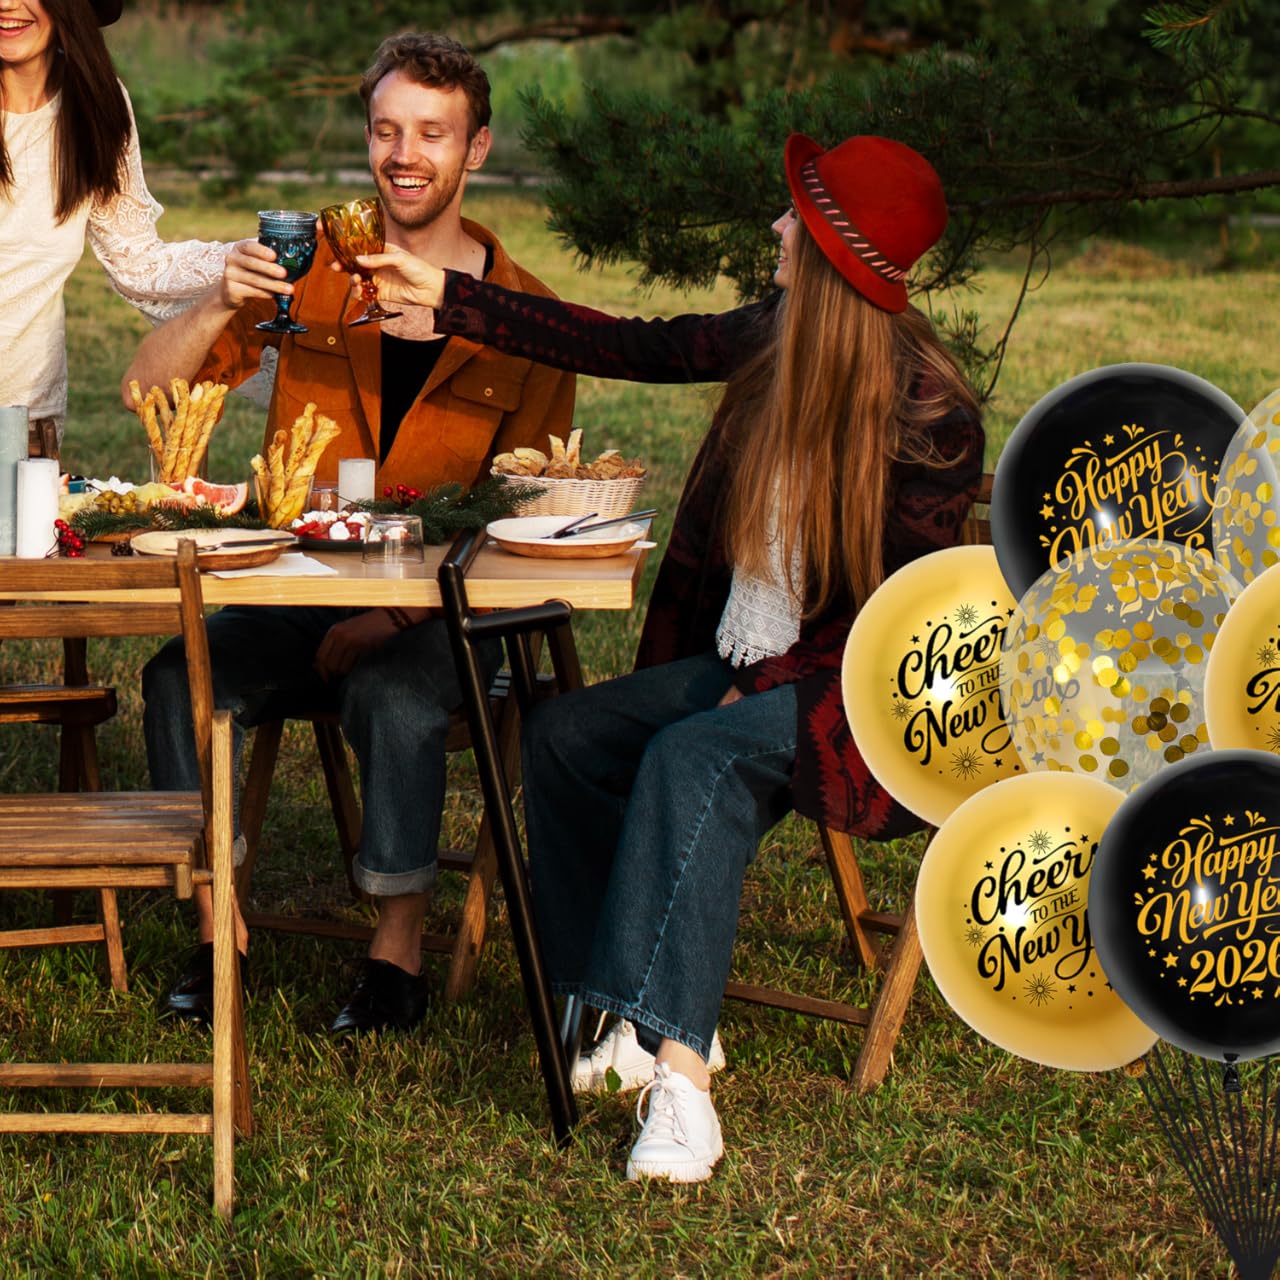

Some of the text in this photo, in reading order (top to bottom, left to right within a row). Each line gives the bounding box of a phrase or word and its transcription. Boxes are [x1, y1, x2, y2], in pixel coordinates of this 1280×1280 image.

[1055, 440, 1188, 520] Happy
[1049, 464, 1232, 574] New Year
[957, 680, 976, 698] TO
[904, 700, 987, 766] New
[971, 842, 1099, 926] Cheer
[1162, 831, 1280, 889] Happy
[1030, 888, 1081, 924] TO THE
[1136, 877, 1280, 944] New Ye
[977, 926, 1061, 992] New
